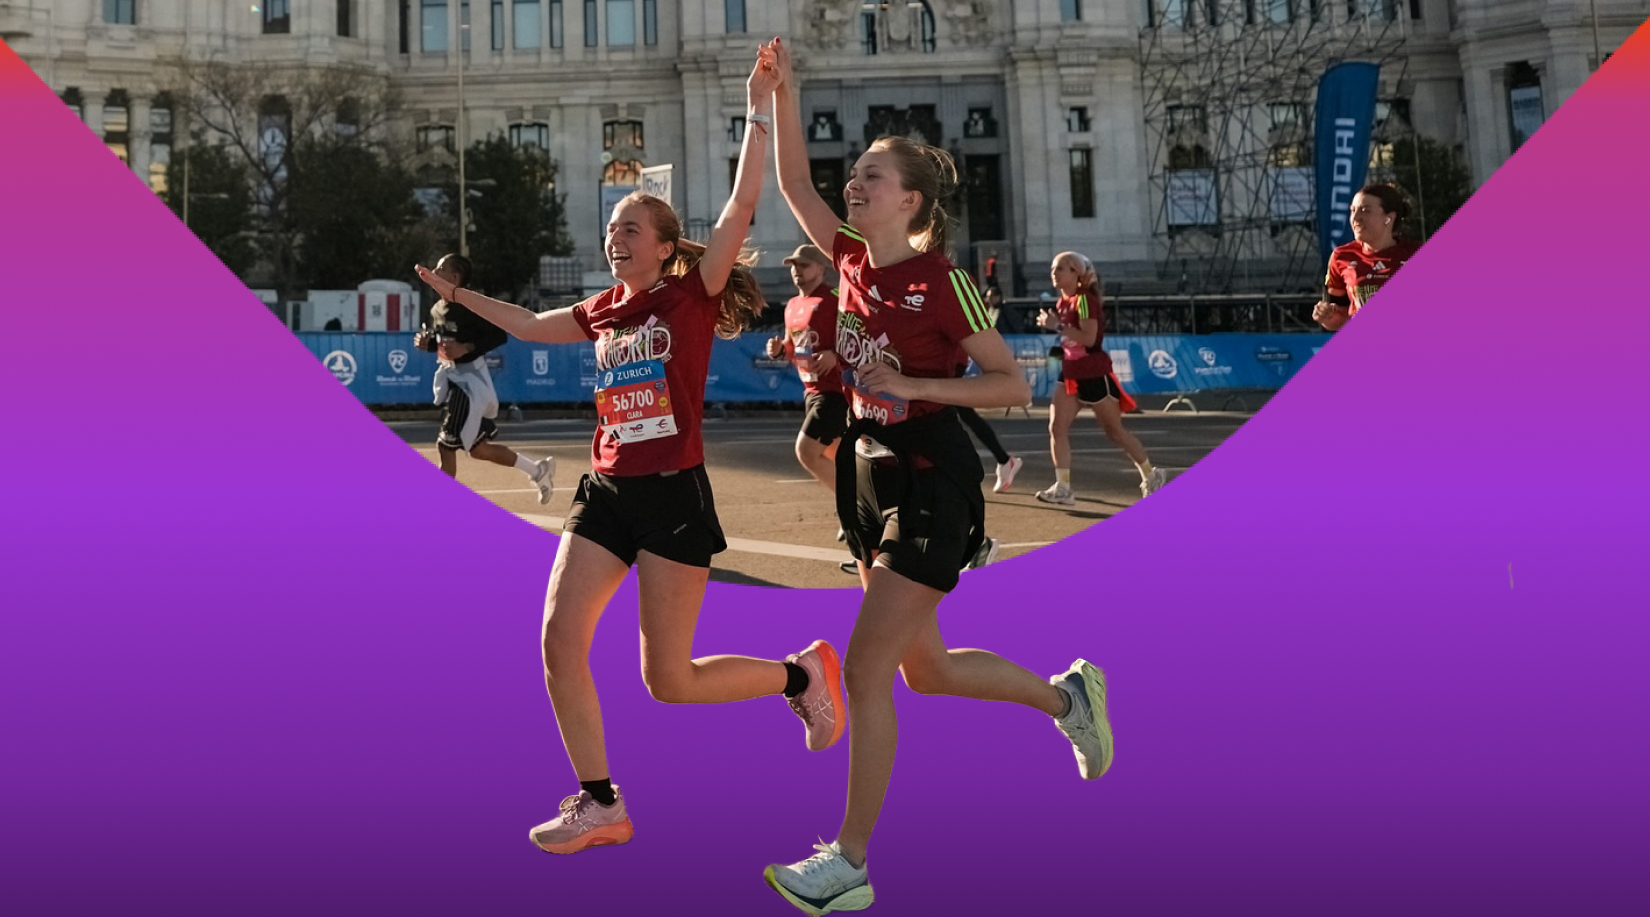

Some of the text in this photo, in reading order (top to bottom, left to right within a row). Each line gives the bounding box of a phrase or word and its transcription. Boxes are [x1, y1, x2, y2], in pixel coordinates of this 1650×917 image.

[1331, 117, 1356, 249] UNDAI
[616, 366, 653, 381] ZURICH
[612, 389, 655, 412] 56700
[626, 411, 643, 420] CLARA
